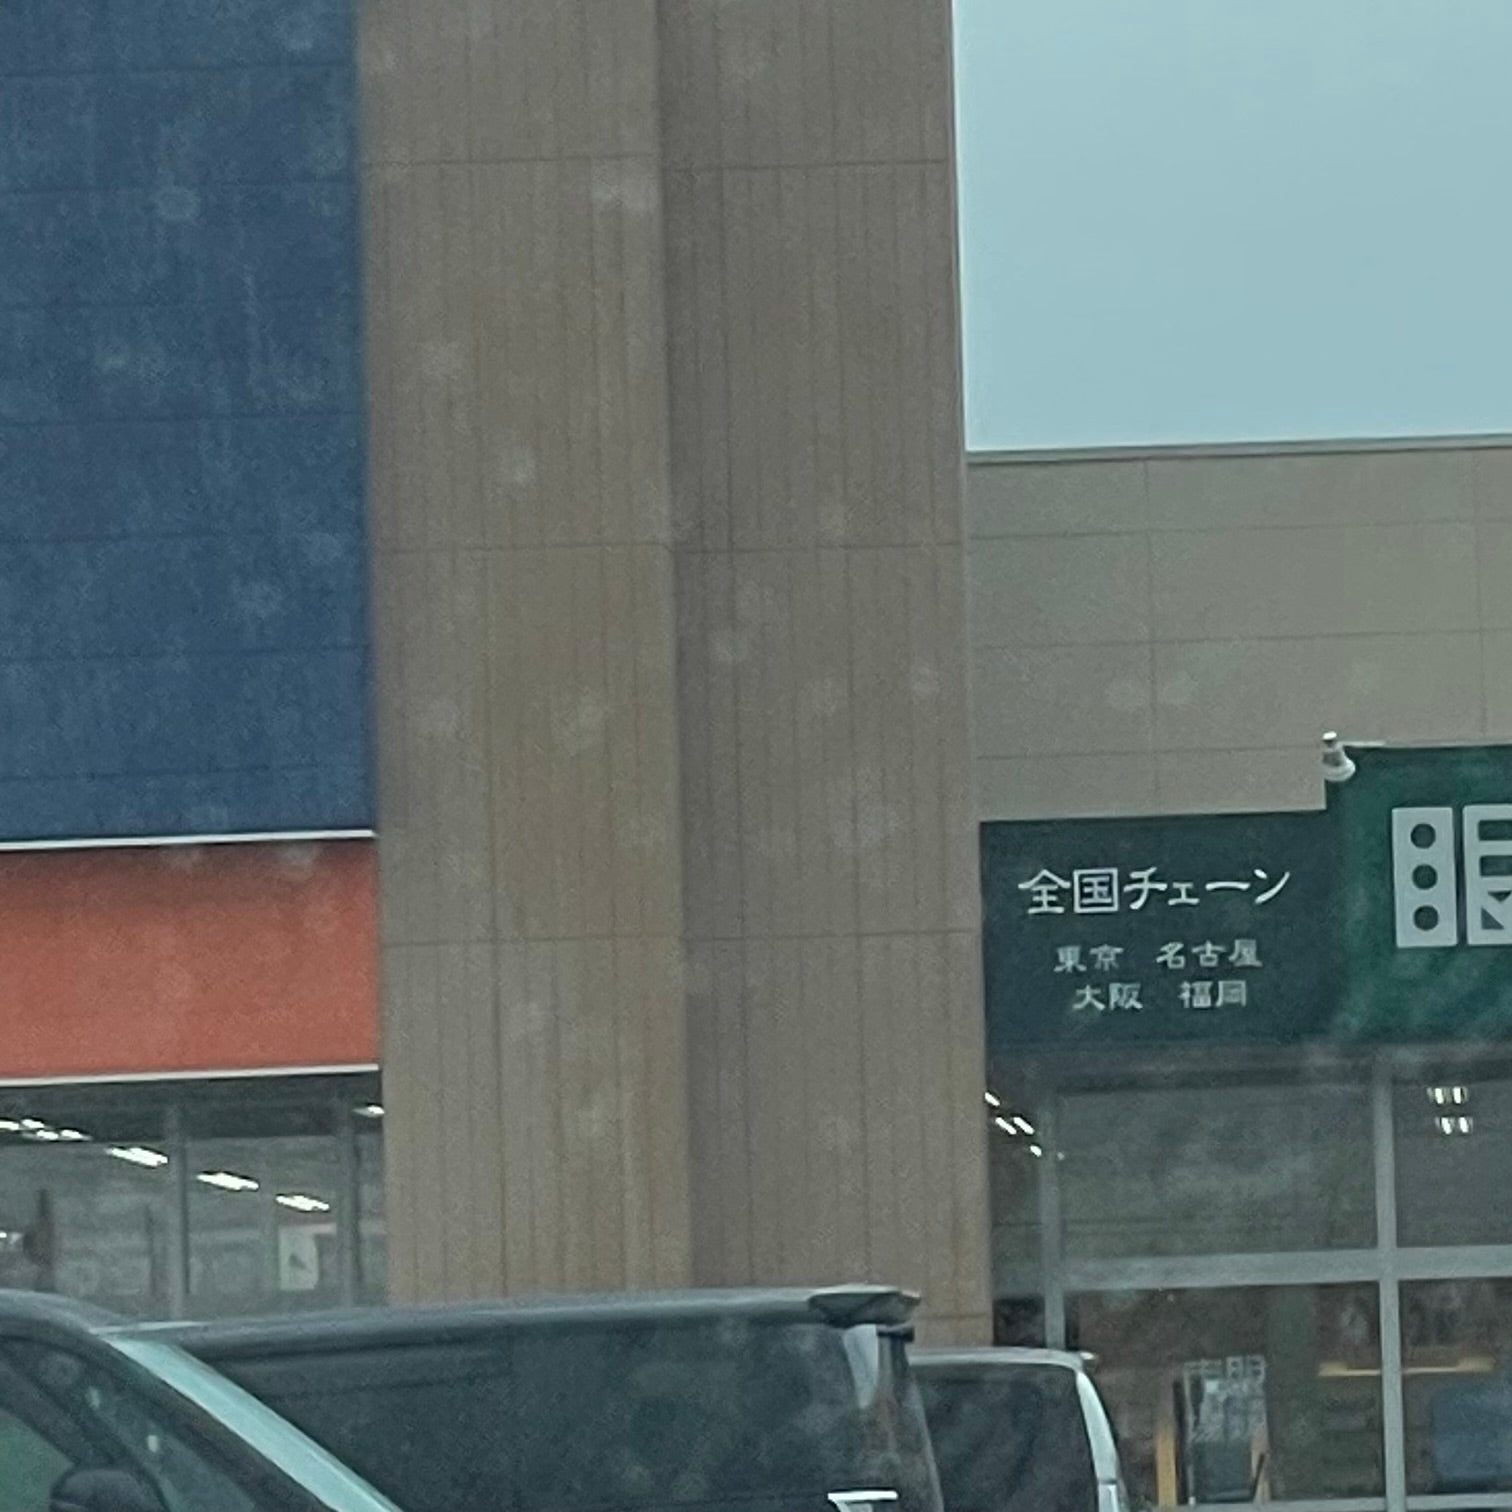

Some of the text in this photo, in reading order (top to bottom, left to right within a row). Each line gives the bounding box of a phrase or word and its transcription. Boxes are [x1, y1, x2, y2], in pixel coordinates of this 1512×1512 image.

[1017, 866, 1291, 915] 全国チェーン
[1053, 938, 1264, 973] 東京 名古屋
[1071, 979, 1248, 1012] 大阪 福岡
